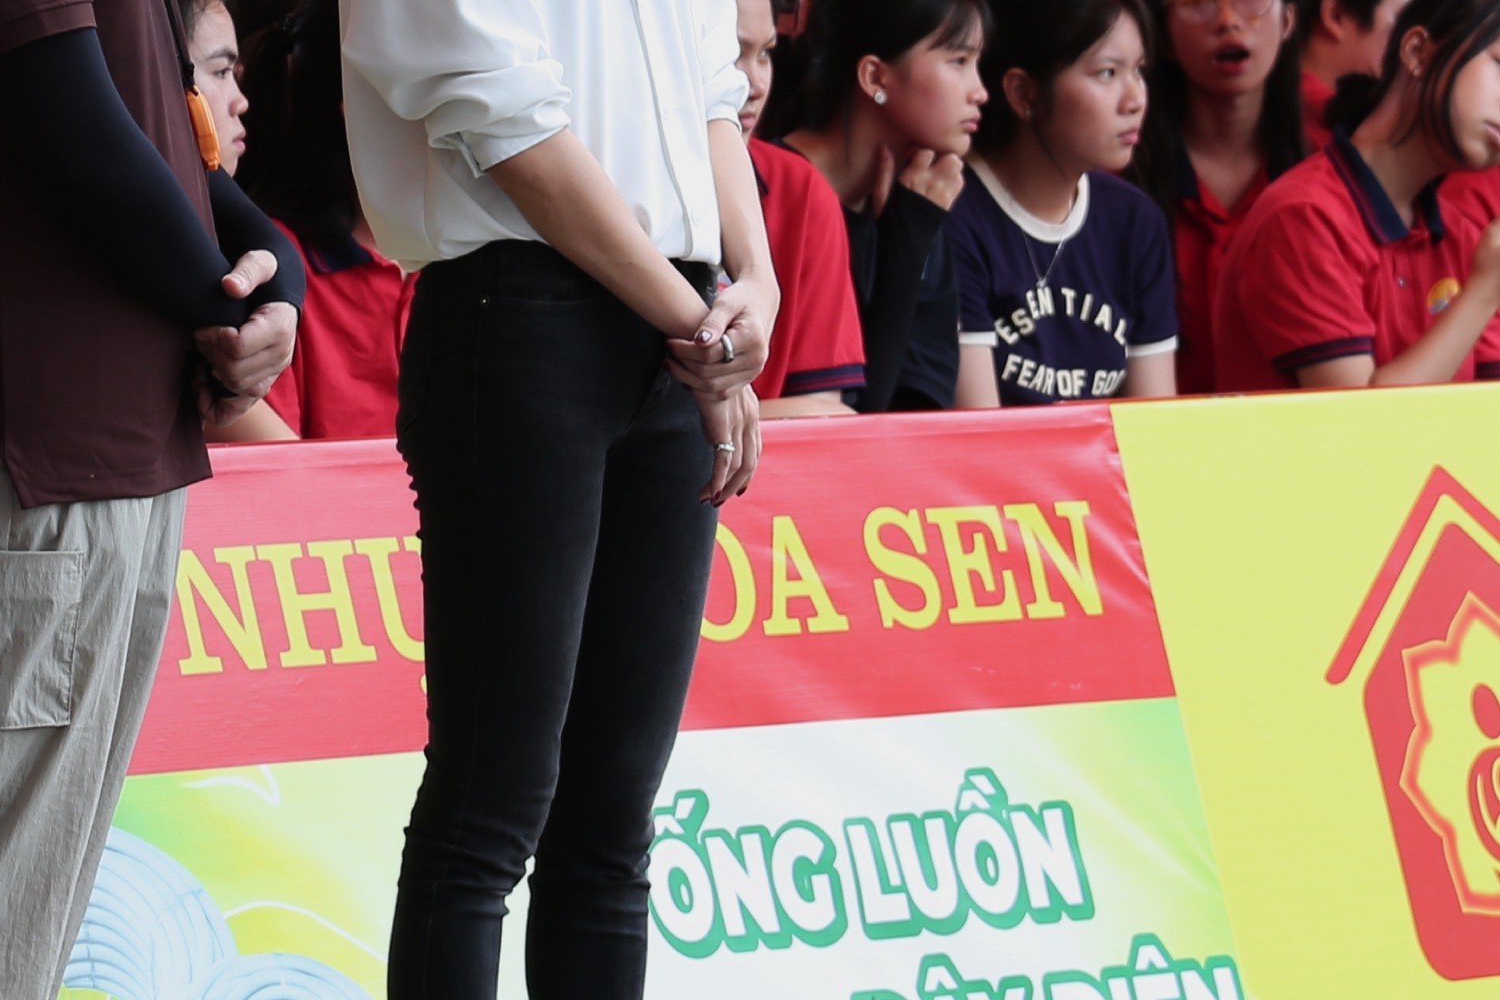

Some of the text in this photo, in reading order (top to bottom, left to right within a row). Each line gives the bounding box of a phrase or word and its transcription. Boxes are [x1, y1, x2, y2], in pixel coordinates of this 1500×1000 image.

[1002, 353, 1055, 395] FEAR
[1057, 369, 1086, 397] OF
[700, 515, 850, 642] OA
[862, 500, 1103, 630] SEN
[843, 768, 1095, 940] LUỒN
